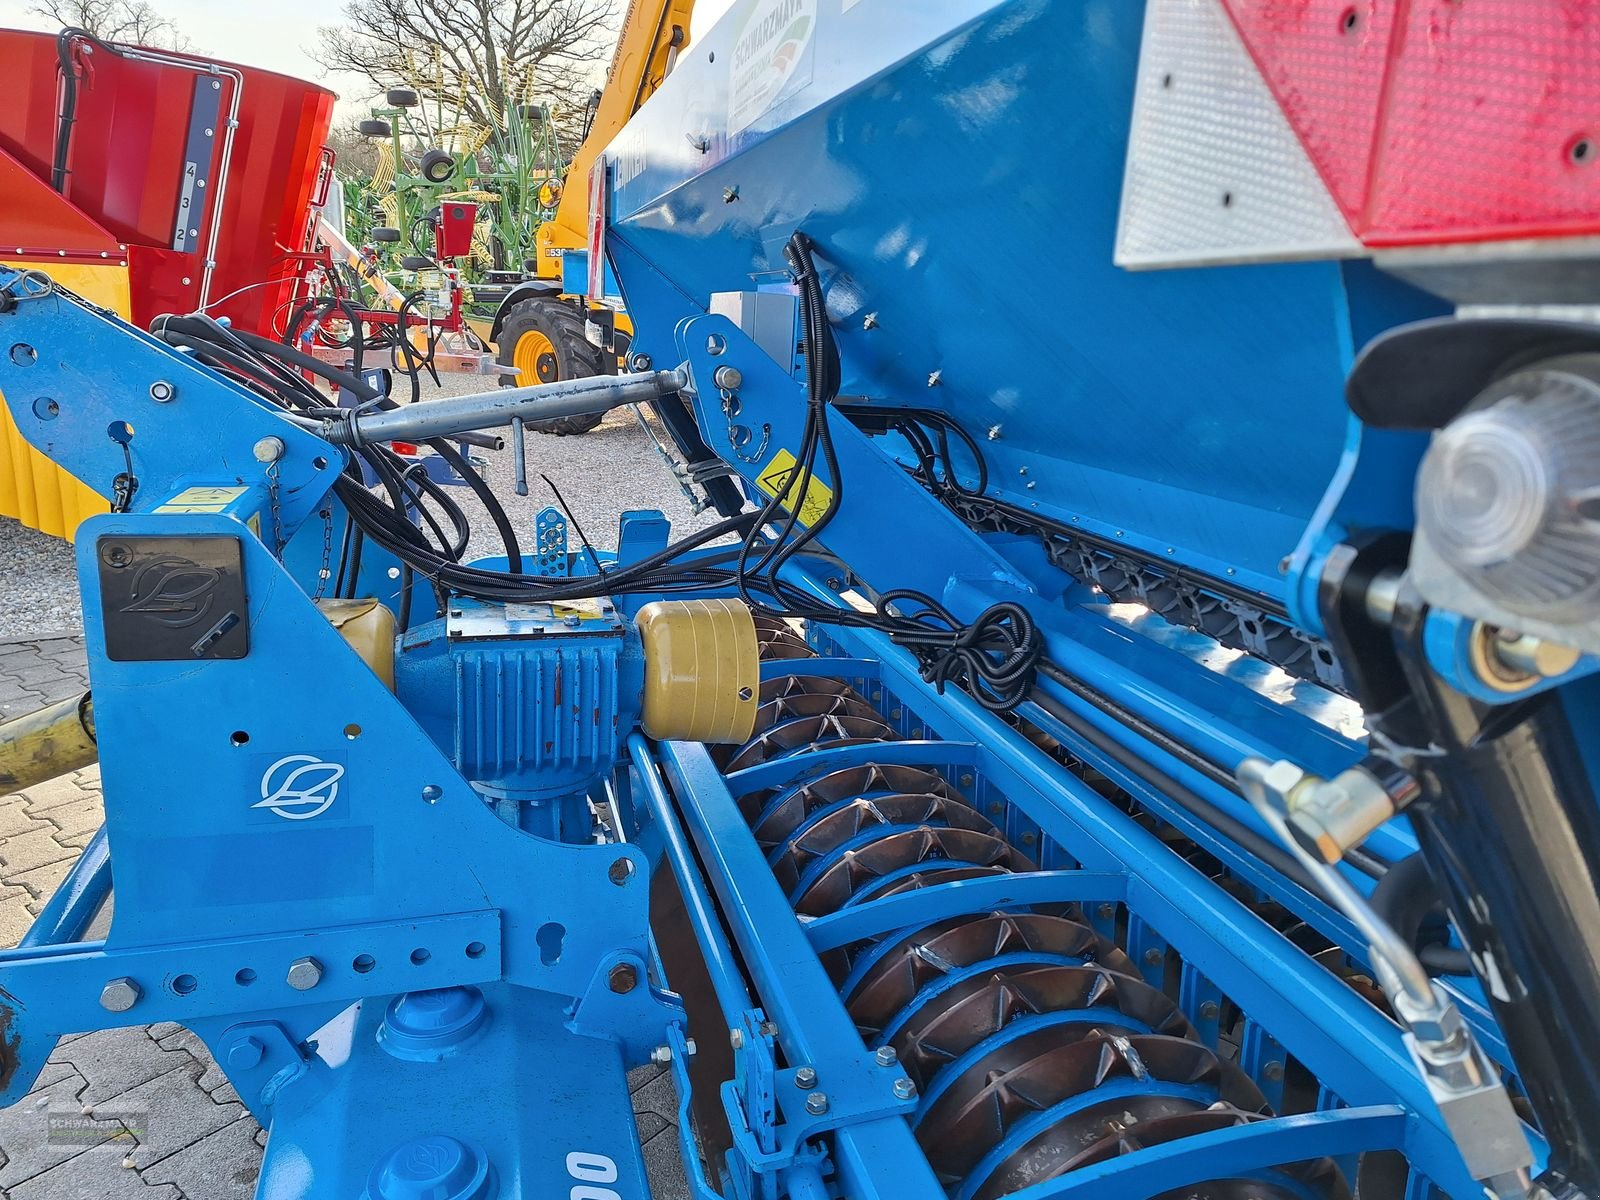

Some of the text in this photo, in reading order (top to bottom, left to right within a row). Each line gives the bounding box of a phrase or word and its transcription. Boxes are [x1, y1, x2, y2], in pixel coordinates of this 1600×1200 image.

[187, 165, 194, 177] 4
[182, 197, 190, 208] 3
[177, 229, 184, 240] 2
